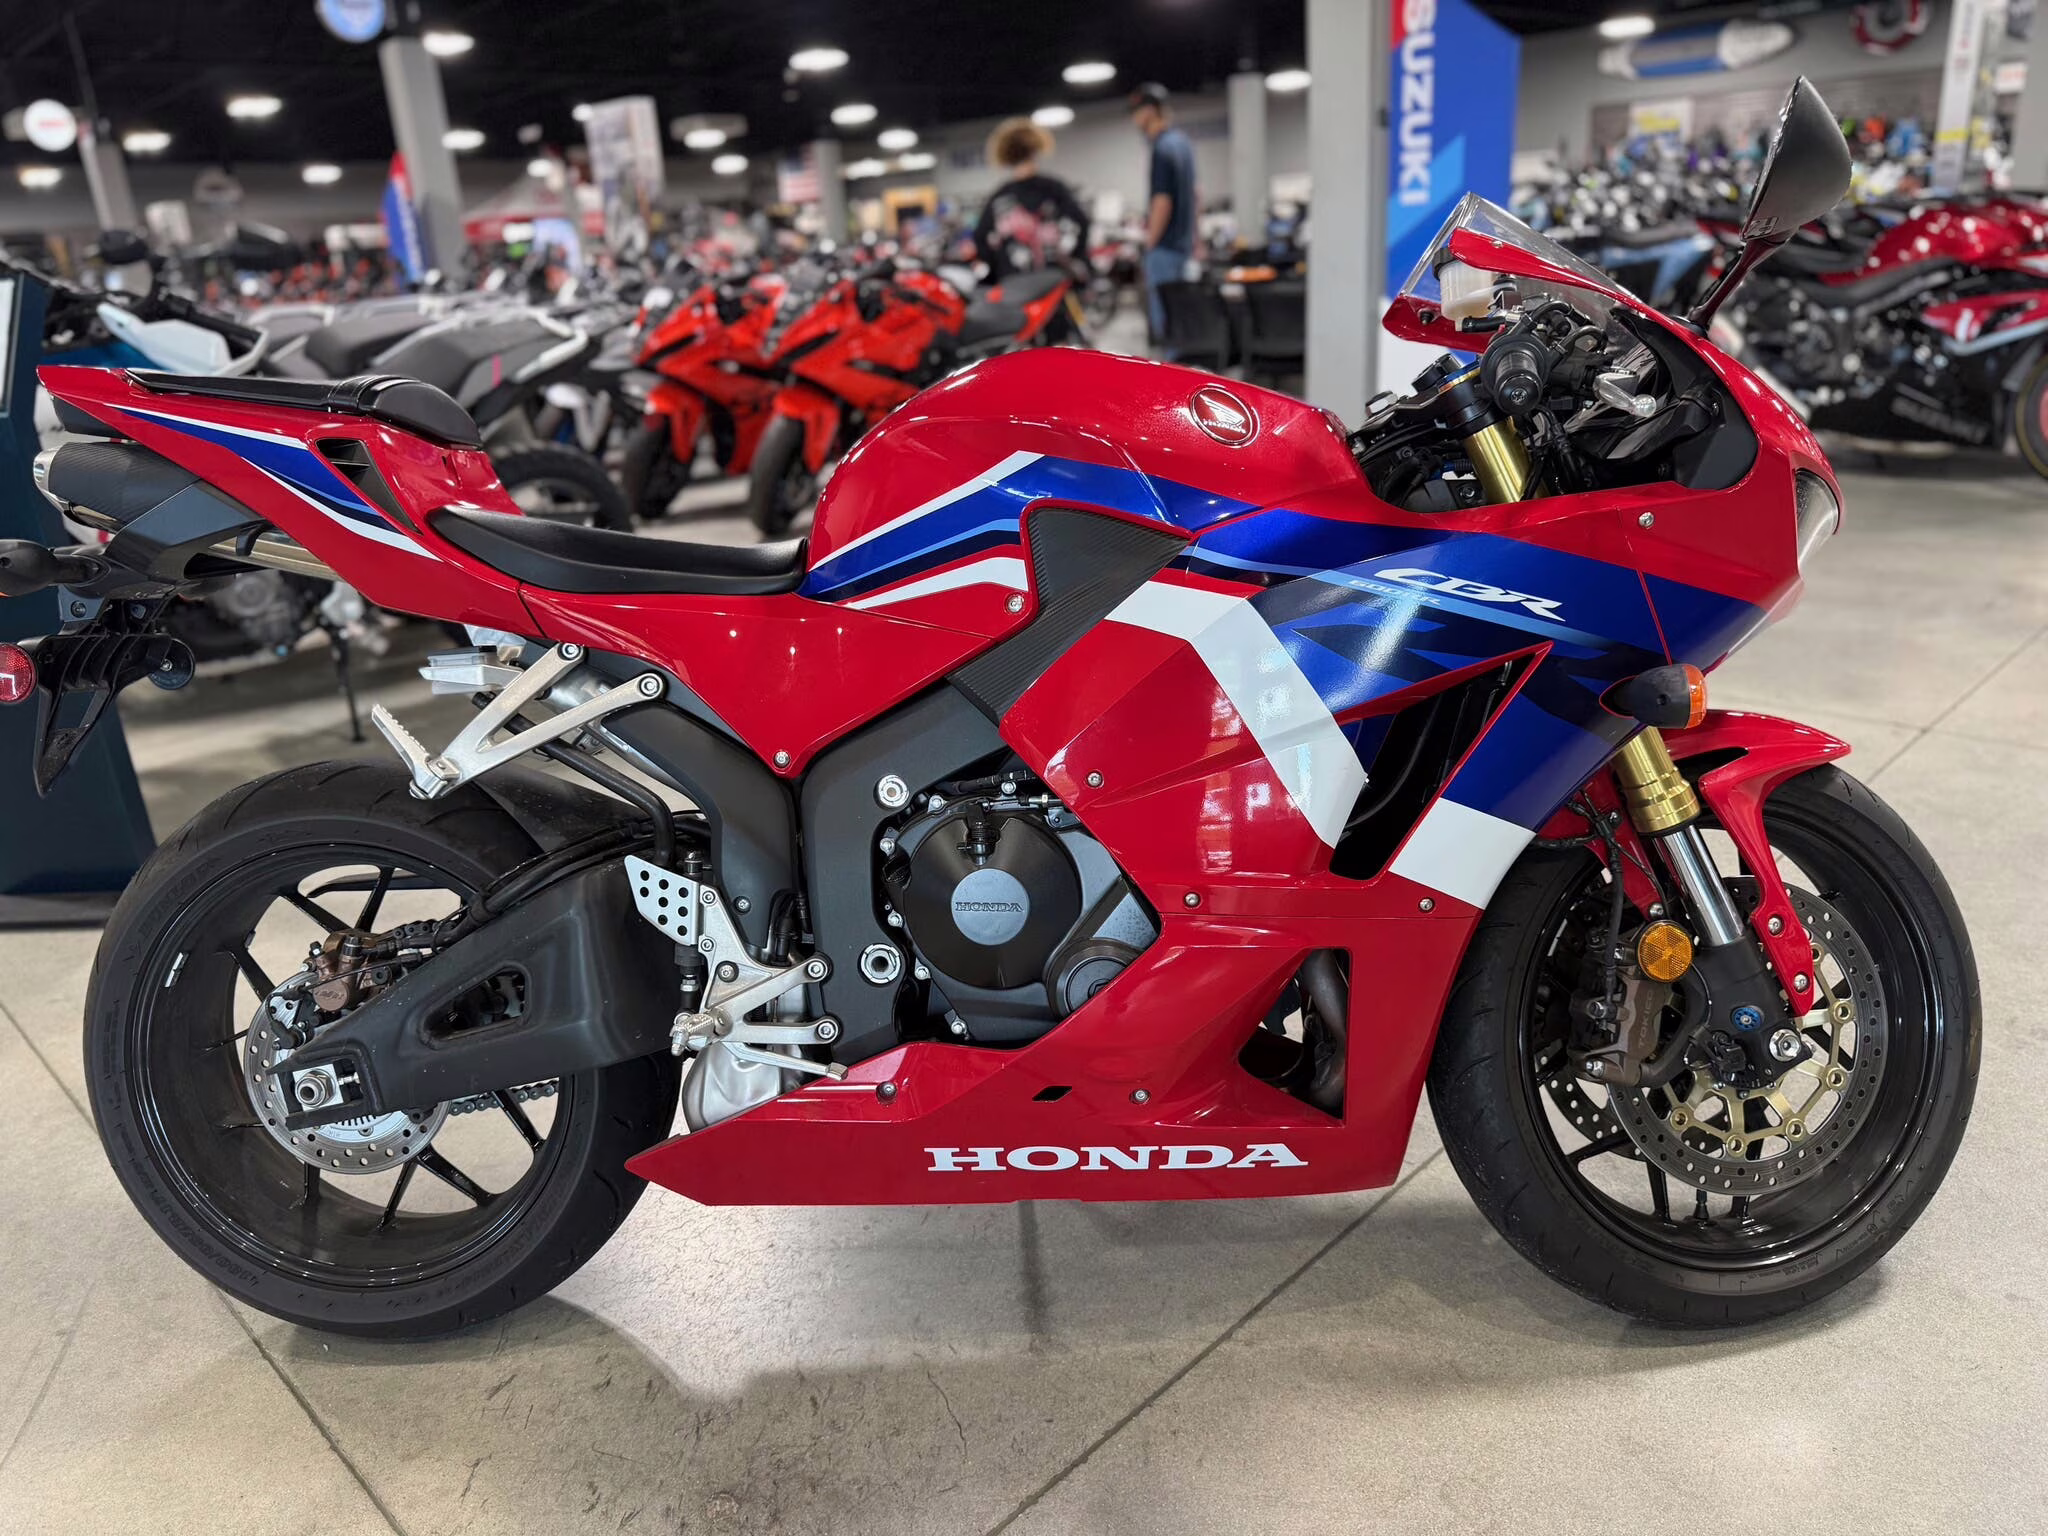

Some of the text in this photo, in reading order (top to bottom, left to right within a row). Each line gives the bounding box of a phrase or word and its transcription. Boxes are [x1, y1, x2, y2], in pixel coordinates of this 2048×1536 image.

[1400, 0, 1436, 205] SUZUKI
[1374, 568, 1566, 622] CBR
[955, 901, 1024, 912] HONDA
[1638, 988, 1654, 1049] TOKICO
[923, 1143, 1309, 1172] HONDA
